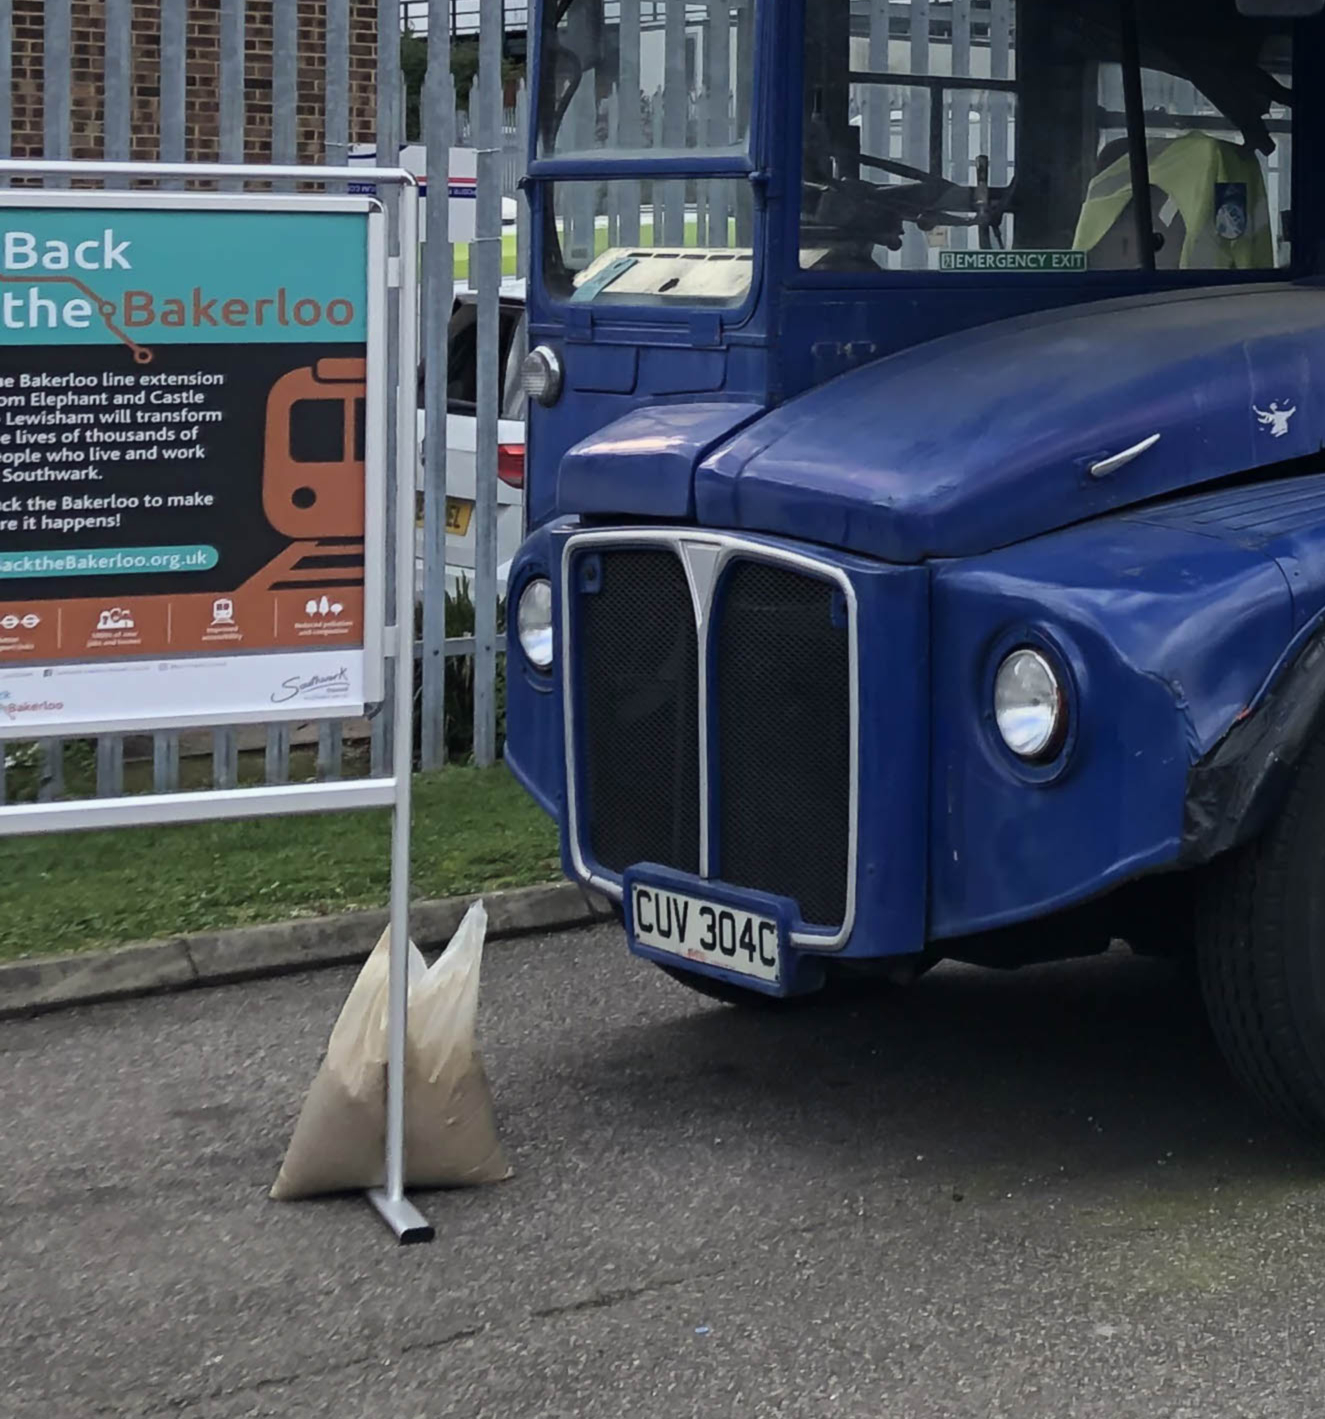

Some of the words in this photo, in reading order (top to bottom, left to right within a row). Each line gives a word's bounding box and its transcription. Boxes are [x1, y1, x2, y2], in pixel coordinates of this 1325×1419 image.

[3, 229, 132, 271] Back
[956, 254, 1046, 268] EMERGENCY
[1052, 254, 1082, 267] EXIT
[3, 287, 92, 328] the
[124, 287, 354, 327] Bakerloo
[19, 373, 98, 388] Bakerloo
[102, 372, 135, 387] line
[139, 371, 224, 386] extension
[30, 391, 108, 409] Elephant
[113, 390, 145, 405] and
[150, 389, 204, 404] Castle
[6, 410, 94, 425] Lewisham
[99, 409, 130, 423] will
[136, 408, 222, 423] transform
[16, 430, 56, 444] lives
[61, 429, 80, 443] of
[85, 427, 175, 443] thousands
[180, 426, 199, 440] of
[46, 447, 84, 462] who
[89, 447, 120, 461] live
[125, 445, 157, 460] and
[162, 444, 205, 459] work
[3, 465, 103, 482] Southwark.
[27, 496, 56, 510] the
[62, 494, 139, 510] Bakerloo
[144, 494, 162, 507] to
[168, 492, 214, 507] make
[23, 516, 36, 530] it
[42, 514, 120, 532] happens!
[0, 549, 207, 573] acktheBakerloo.org.uk
[7, 700, 64, 713] Bakerloo
[636, 889, 689, 943] CUV
[699, 906, 776, 967] 304C
